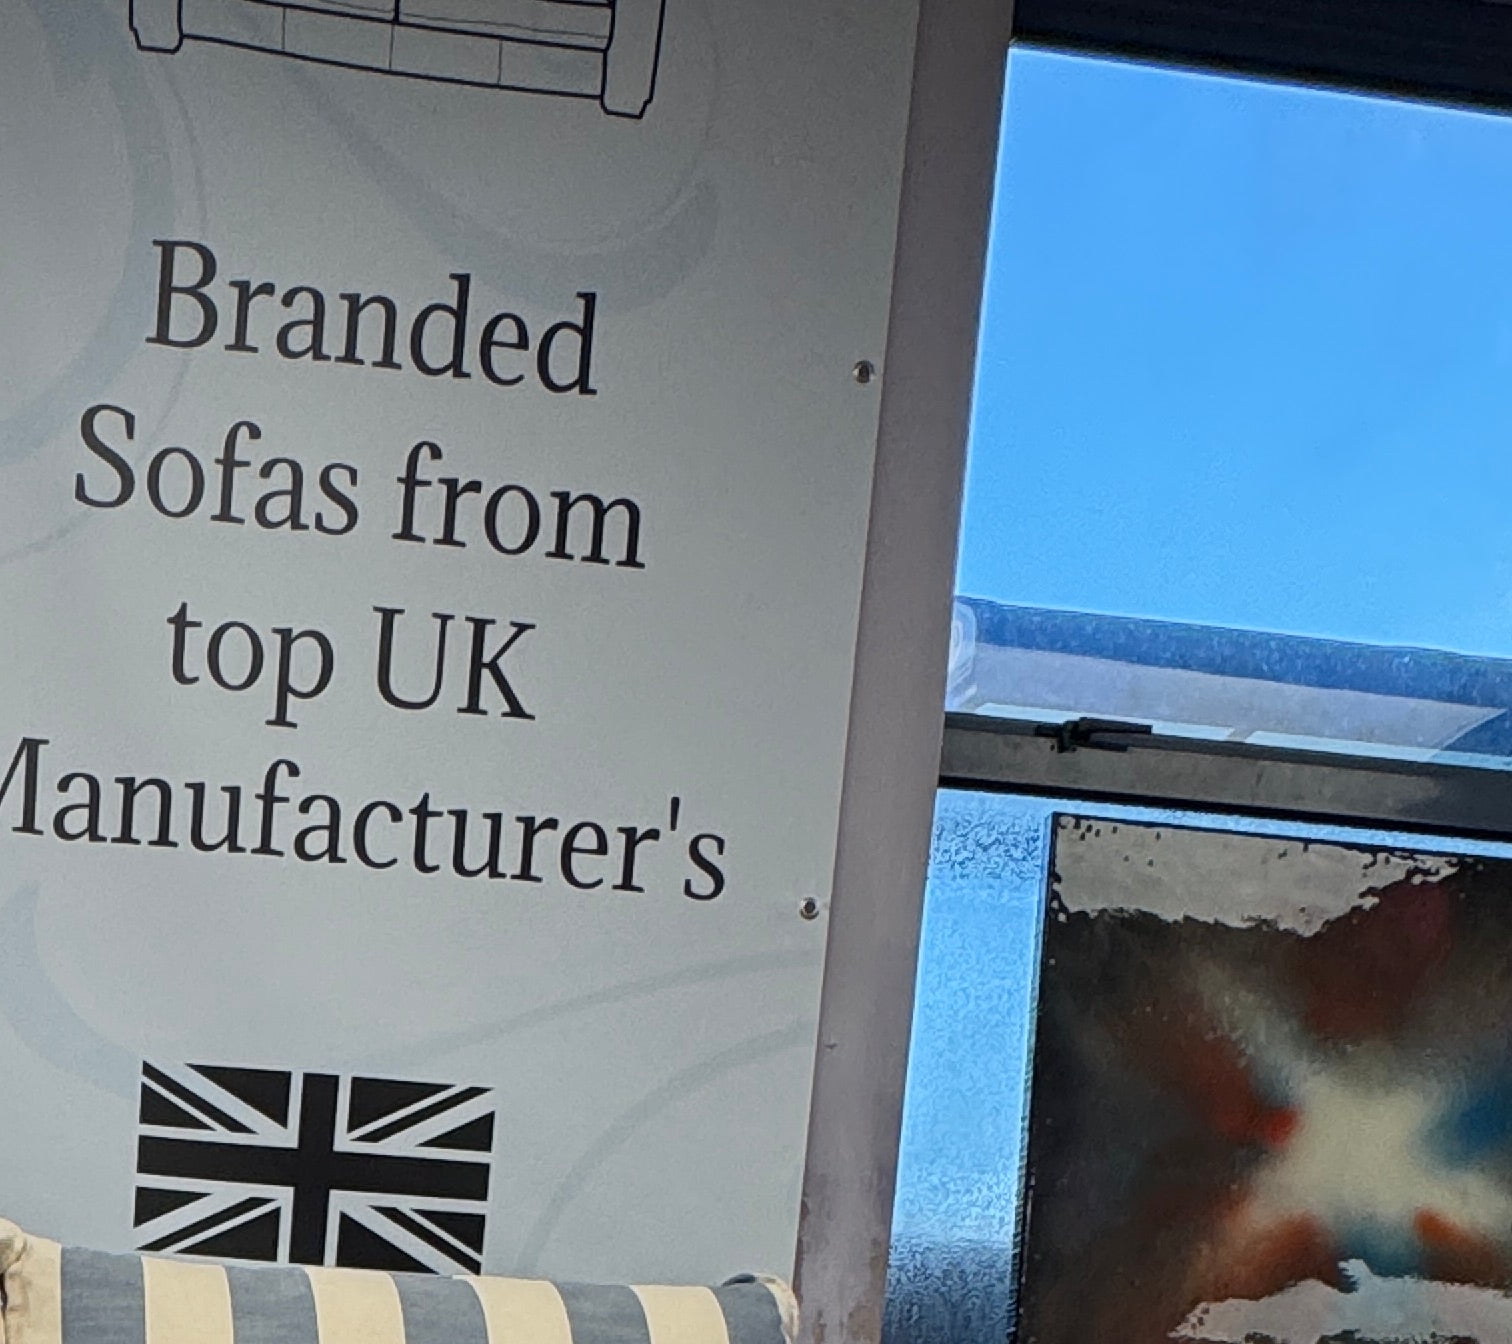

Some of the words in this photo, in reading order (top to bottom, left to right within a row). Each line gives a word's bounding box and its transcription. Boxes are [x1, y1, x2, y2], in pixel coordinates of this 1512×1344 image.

[145, 238, 598, 396] Branded
[74, 404, 359, 536] Sofas
[391, 440, 646, 570] from
[166, 602, 334, 729] top
[372, 606, 536, 721] UK
